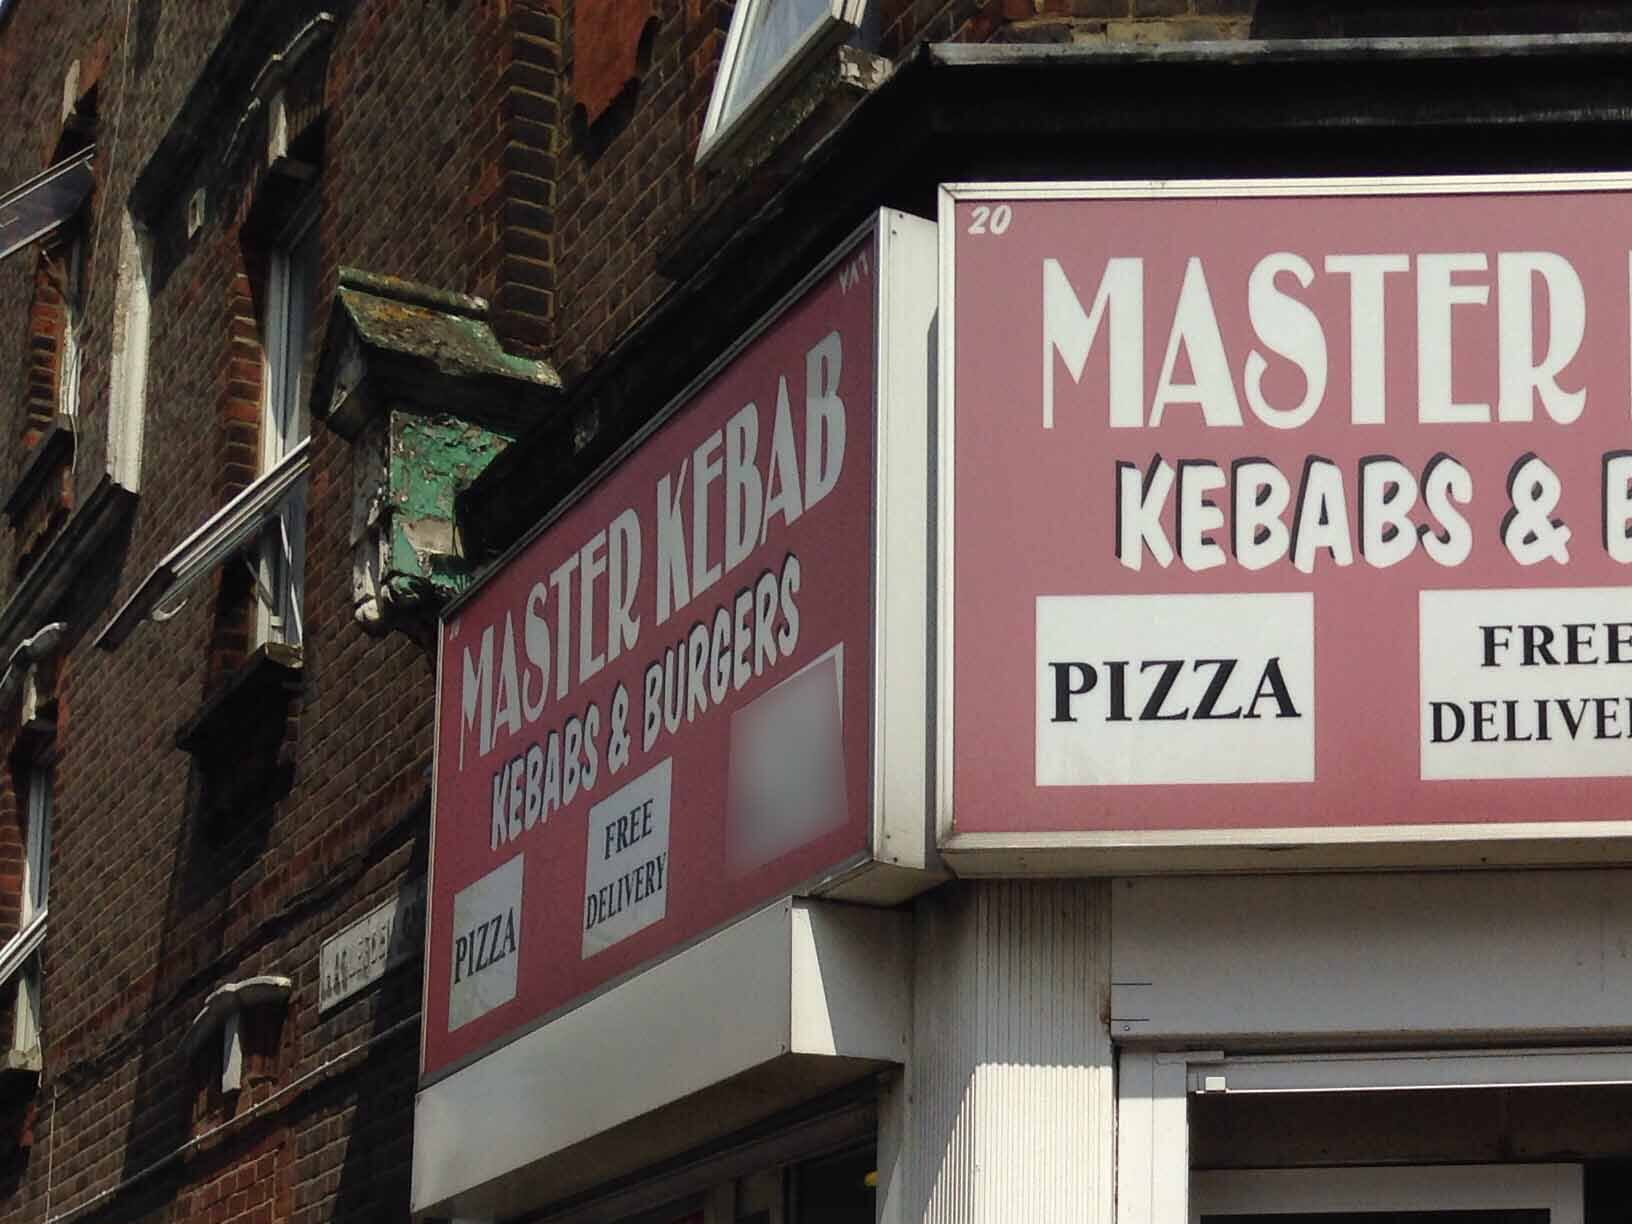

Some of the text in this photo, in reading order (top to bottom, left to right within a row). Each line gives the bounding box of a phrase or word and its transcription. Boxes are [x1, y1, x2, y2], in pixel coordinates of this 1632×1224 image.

[967, 204, 1012, 235] 20
[1043, 251, 1587, 430] MASTER
[459, 329, 847, 771] MASTER KEBAB
[1114, 452, 1473, 575] KEBABS
[1500, 452, 1572, 568] &
[489, 553, 801, 851] KEBABS & BURGERS
[1048, 656, 1302, 723] PIZZA
[603, 799, 654, 860] FREE
[586, 852, 666, 930] DELIVERY
[454, 907, 517, 984] PIZZA
